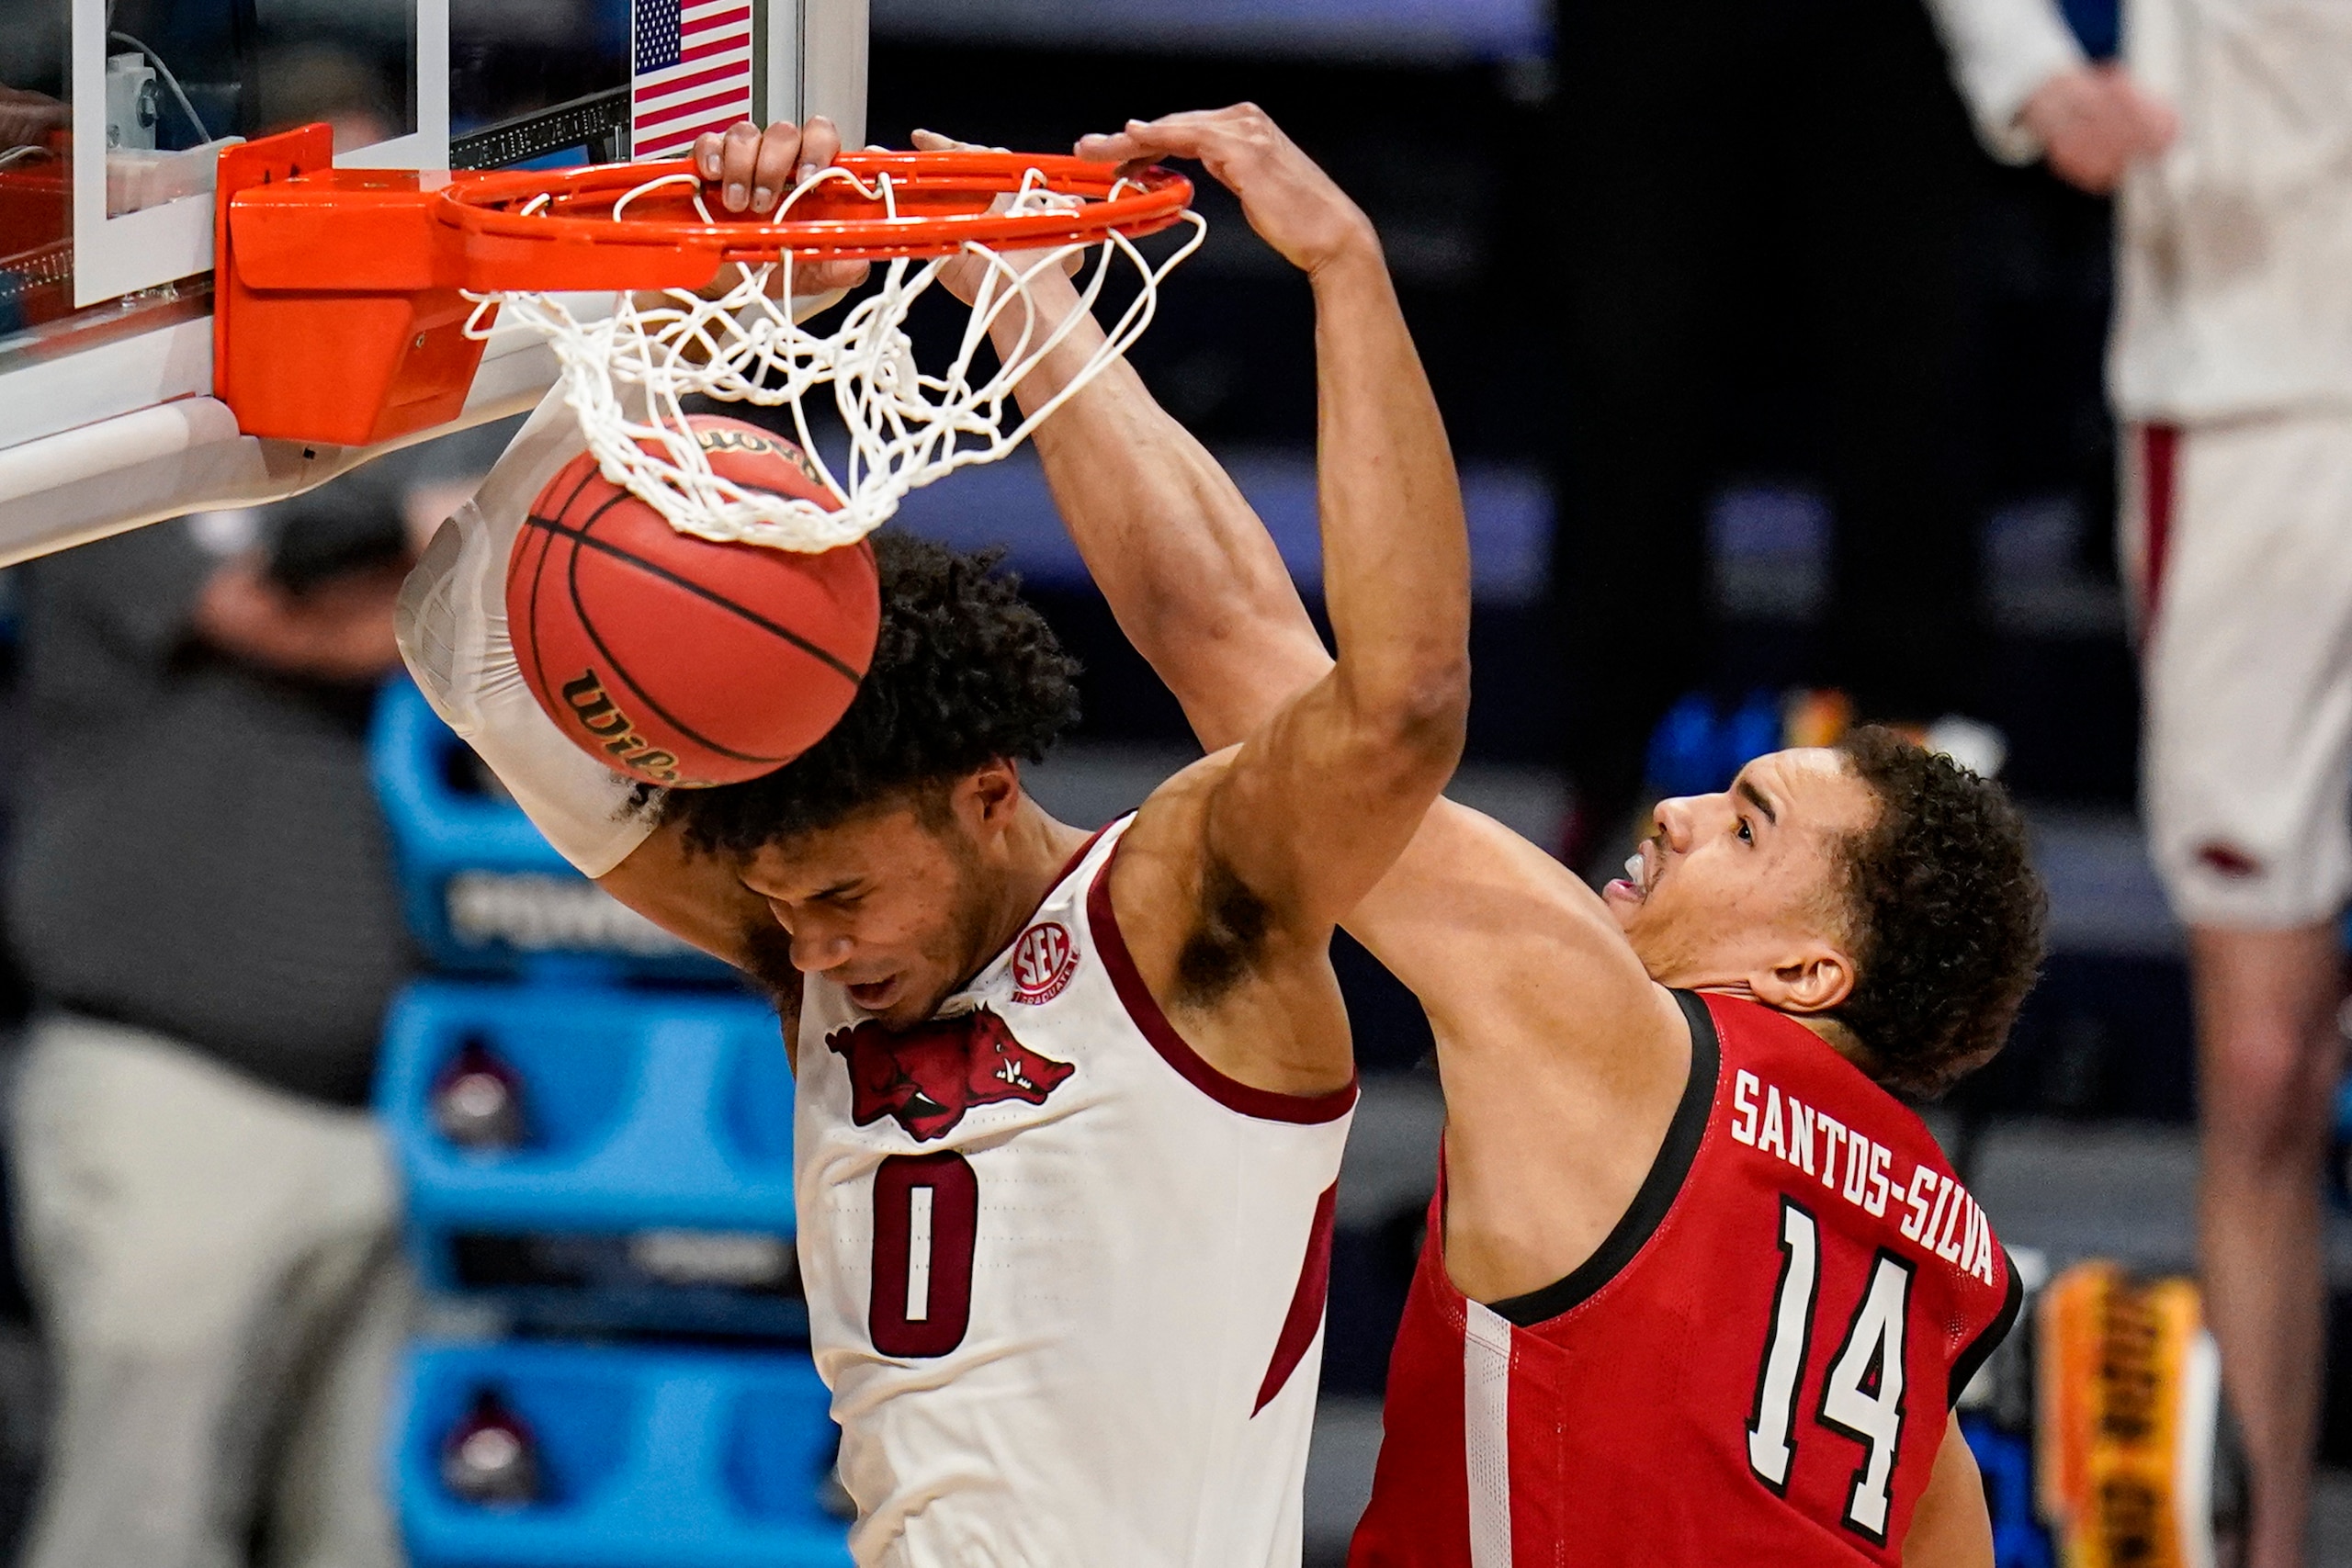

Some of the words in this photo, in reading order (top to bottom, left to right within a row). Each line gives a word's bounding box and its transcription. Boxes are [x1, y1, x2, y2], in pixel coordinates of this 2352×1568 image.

[1016, 925, 1066, 986] SEC
[868, 1148, 978, 1359] 0
[1731, 1068, 1993, 1286] SANTOS-SILVA
[1746, 1193, 1917, 1548] 14
